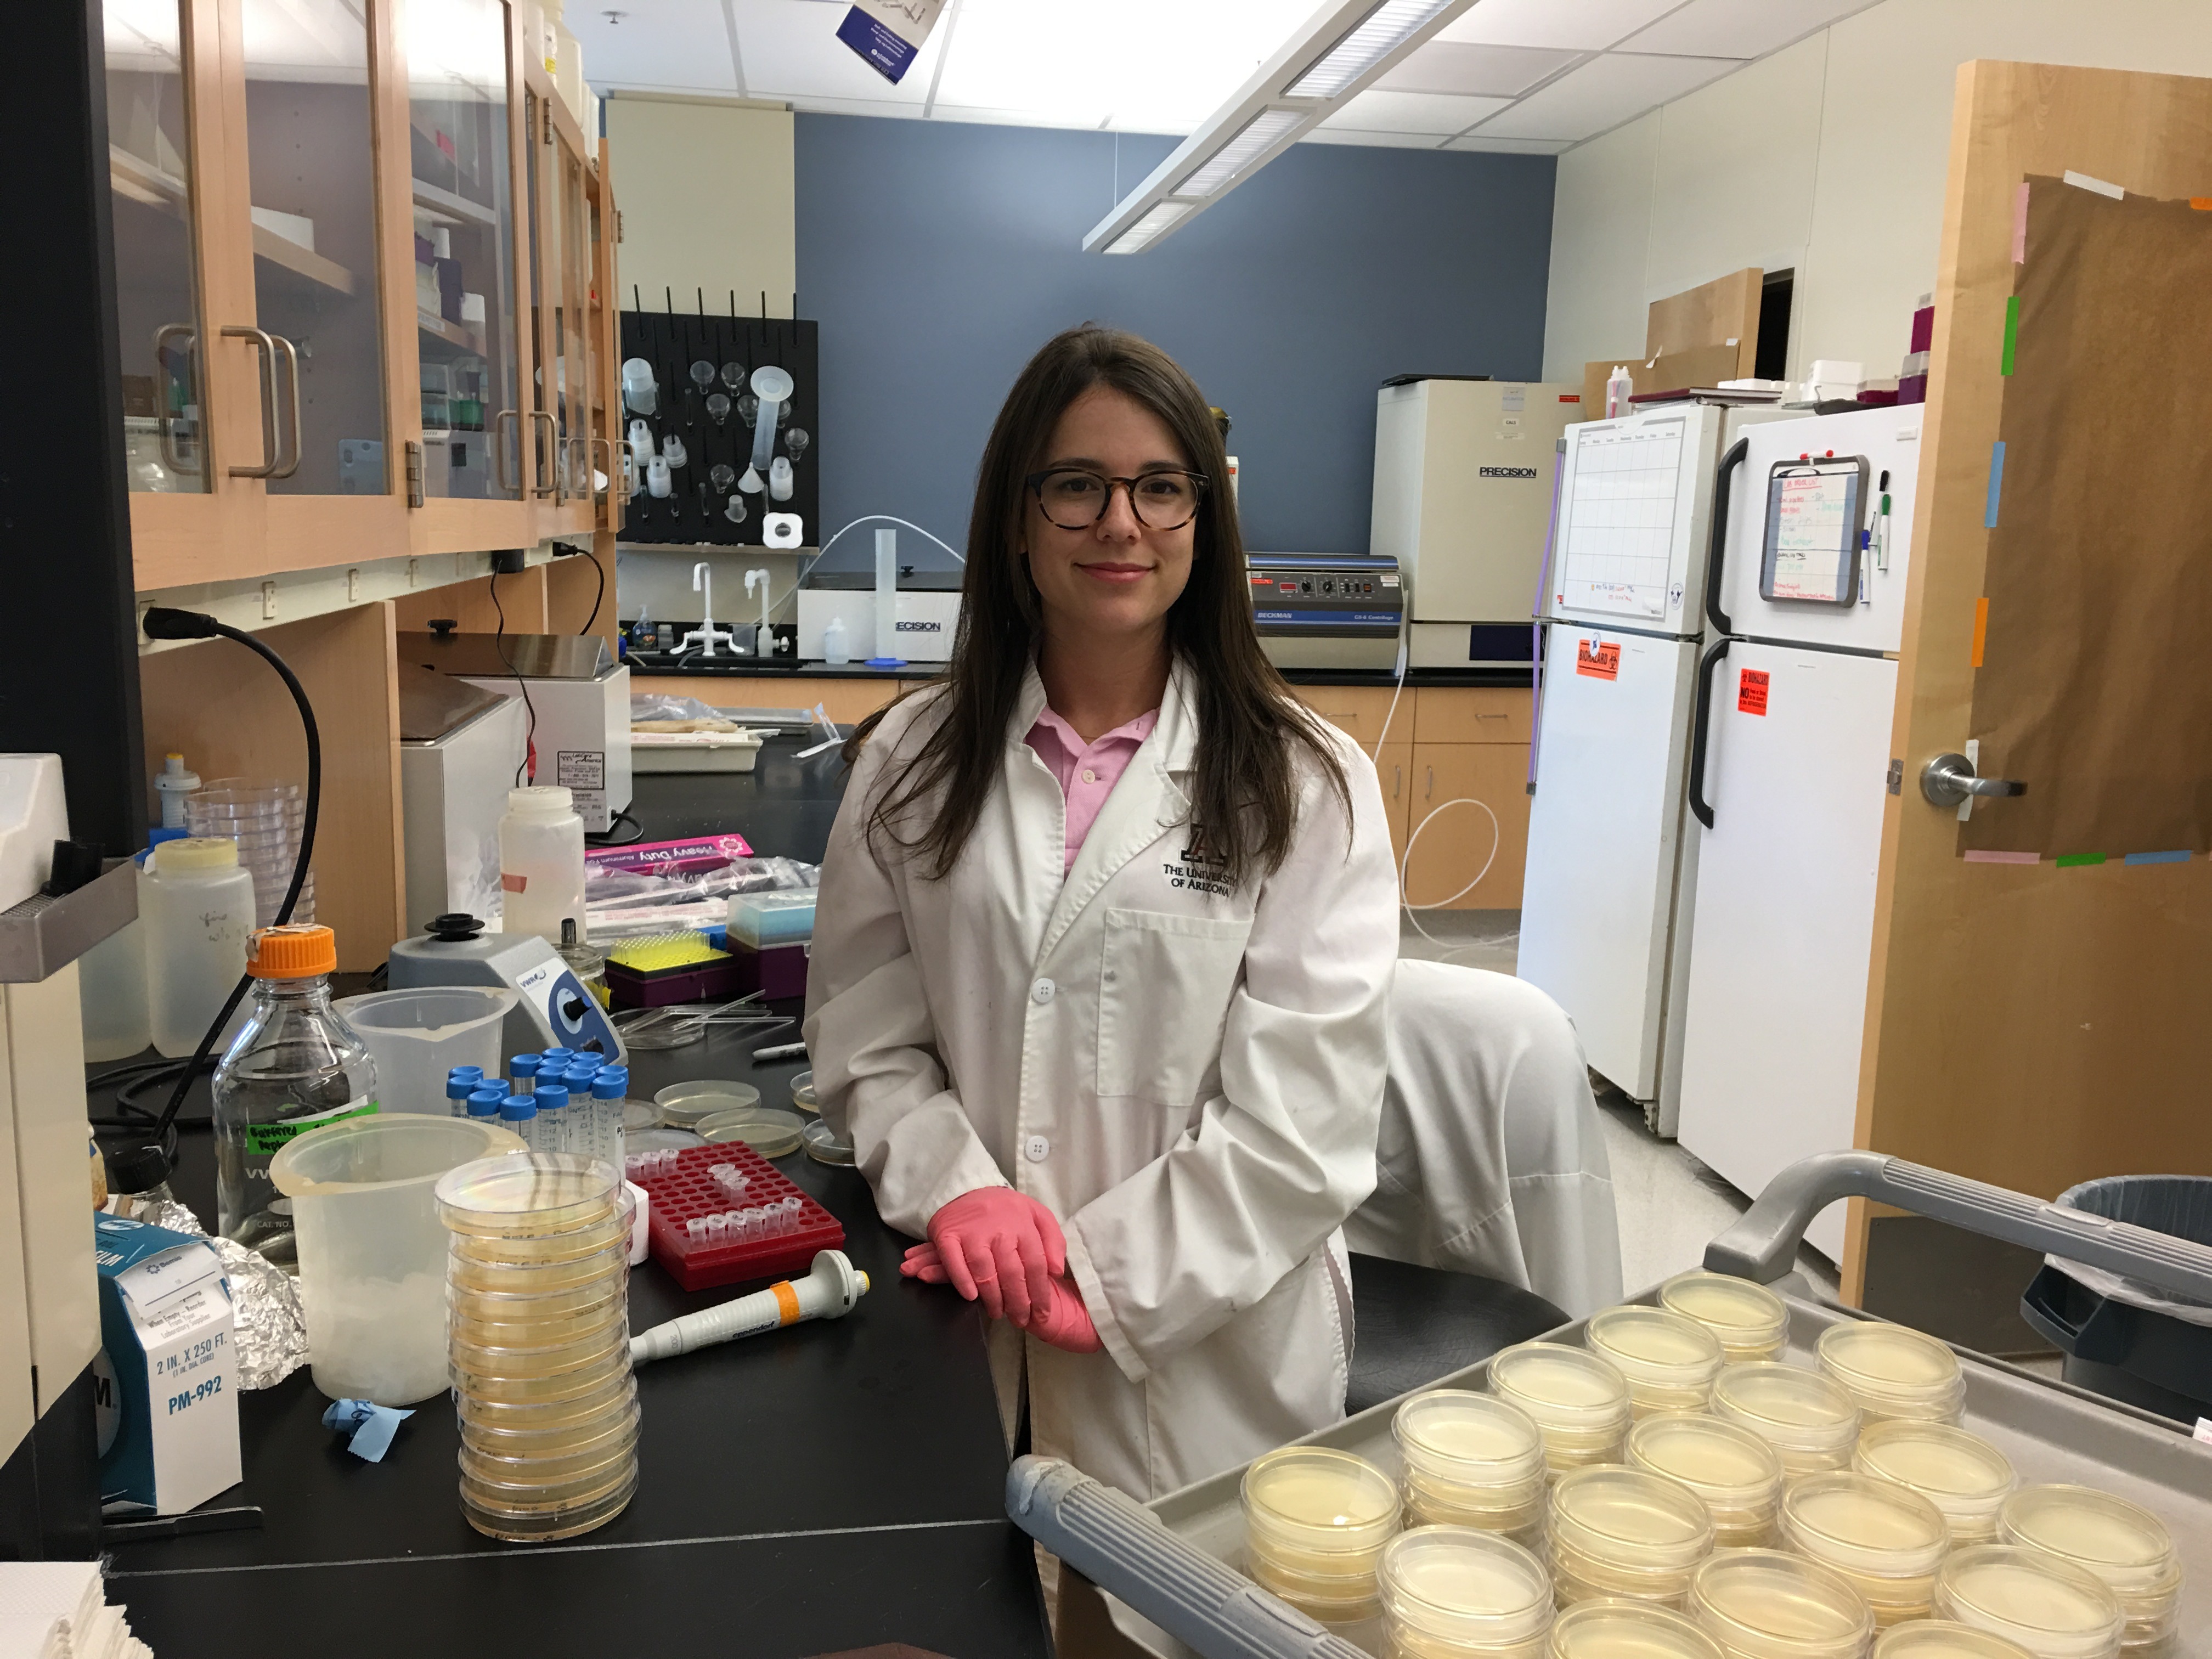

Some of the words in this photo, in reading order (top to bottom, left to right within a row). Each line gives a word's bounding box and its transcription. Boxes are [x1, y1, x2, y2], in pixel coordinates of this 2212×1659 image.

[1480, 467, 1537, 476] PRECISION
[896, 622, 941, 630] ECISION
[1740, 687, 1749, 699] NO
[639, 850, 671, 862] Duty
[673, 845, 713, 857] Heavy
[1164, 864, 1184, 876] THE
[1171, 878, 1186, 888] OF
[1187, 878, 1229, 897] ARIZONA
[520, 977, 537, 988] VWR
[147, 1318, 164, 1328] When
[163, 1312, 180, 1322] Empty
[185, 1300, 206, 1312] Reorder
[167, 1318, 183, 1328] From
[182, 1313, 195, 1321] Your
[161, 1323, 190, 1339] Laboratory
[189, 1314, 211, 1326] Supplier
[732, 1321, 775, 1339] eppendorf
[670, 1334, 678, 1349] 200
[157, 1361, 163, 1375] 2
[167, 1355, 180, 1371] IN.
[184, 1348, 190, 1363] X
[194, 1339, 212, 1358] 250
[215, 1332, 228, 1348] FT.
[188, 1361, 199, 1370] DIA.
[200, 1352, 215, 1364] CORE)
[168, 1375, 222, 1415] PM-992
